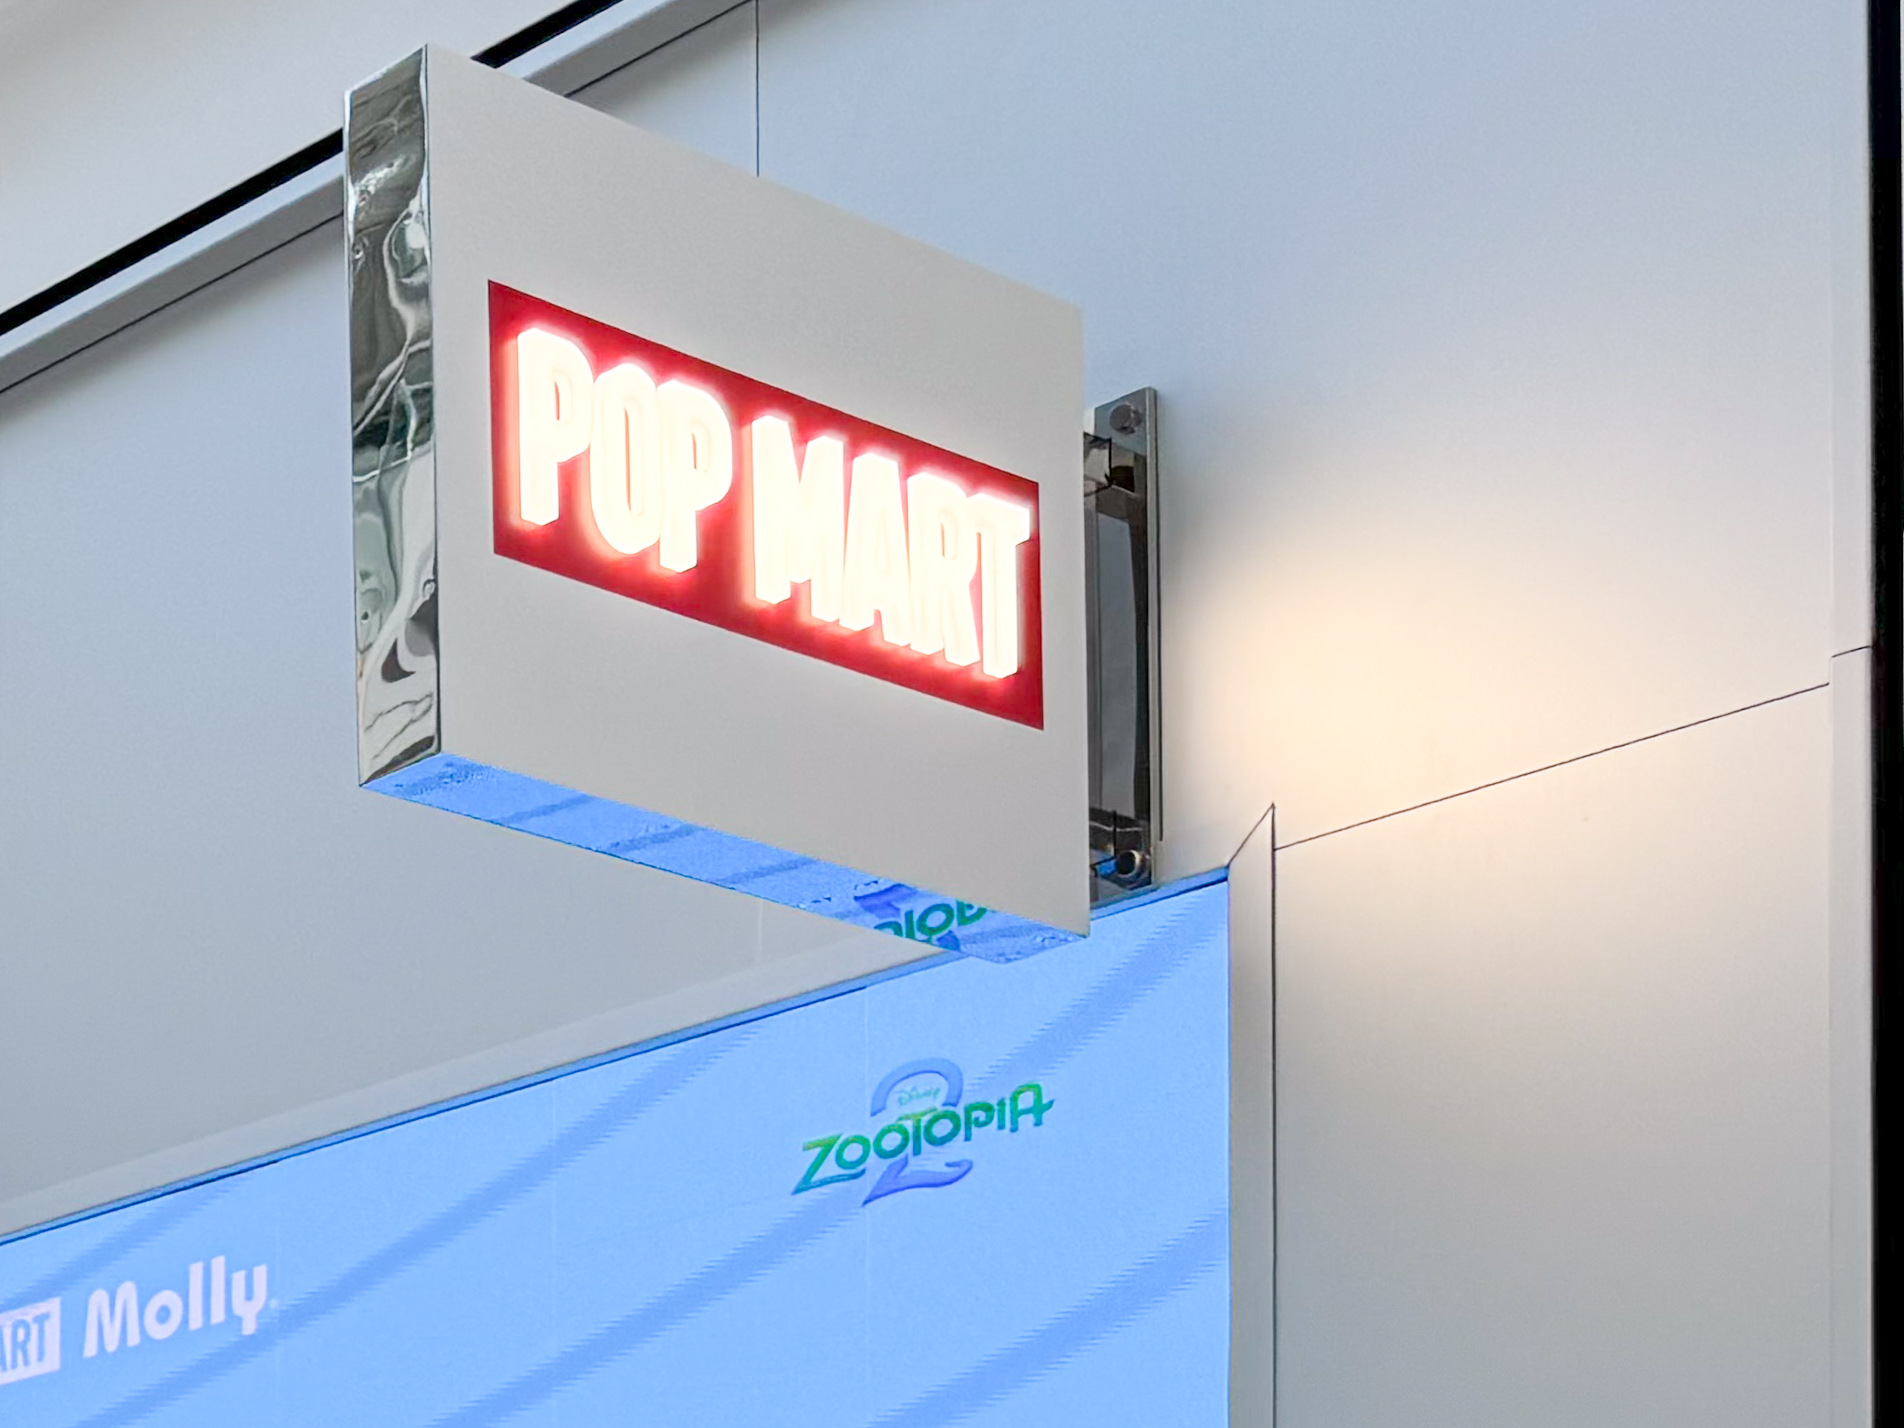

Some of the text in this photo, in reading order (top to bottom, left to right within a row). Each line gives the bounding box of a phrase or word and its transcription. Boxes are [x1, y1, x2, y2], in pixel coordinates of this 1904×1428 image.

[515, 326, 1031, 679] POP MART
[82, 1254, 268, 1359] Molly
